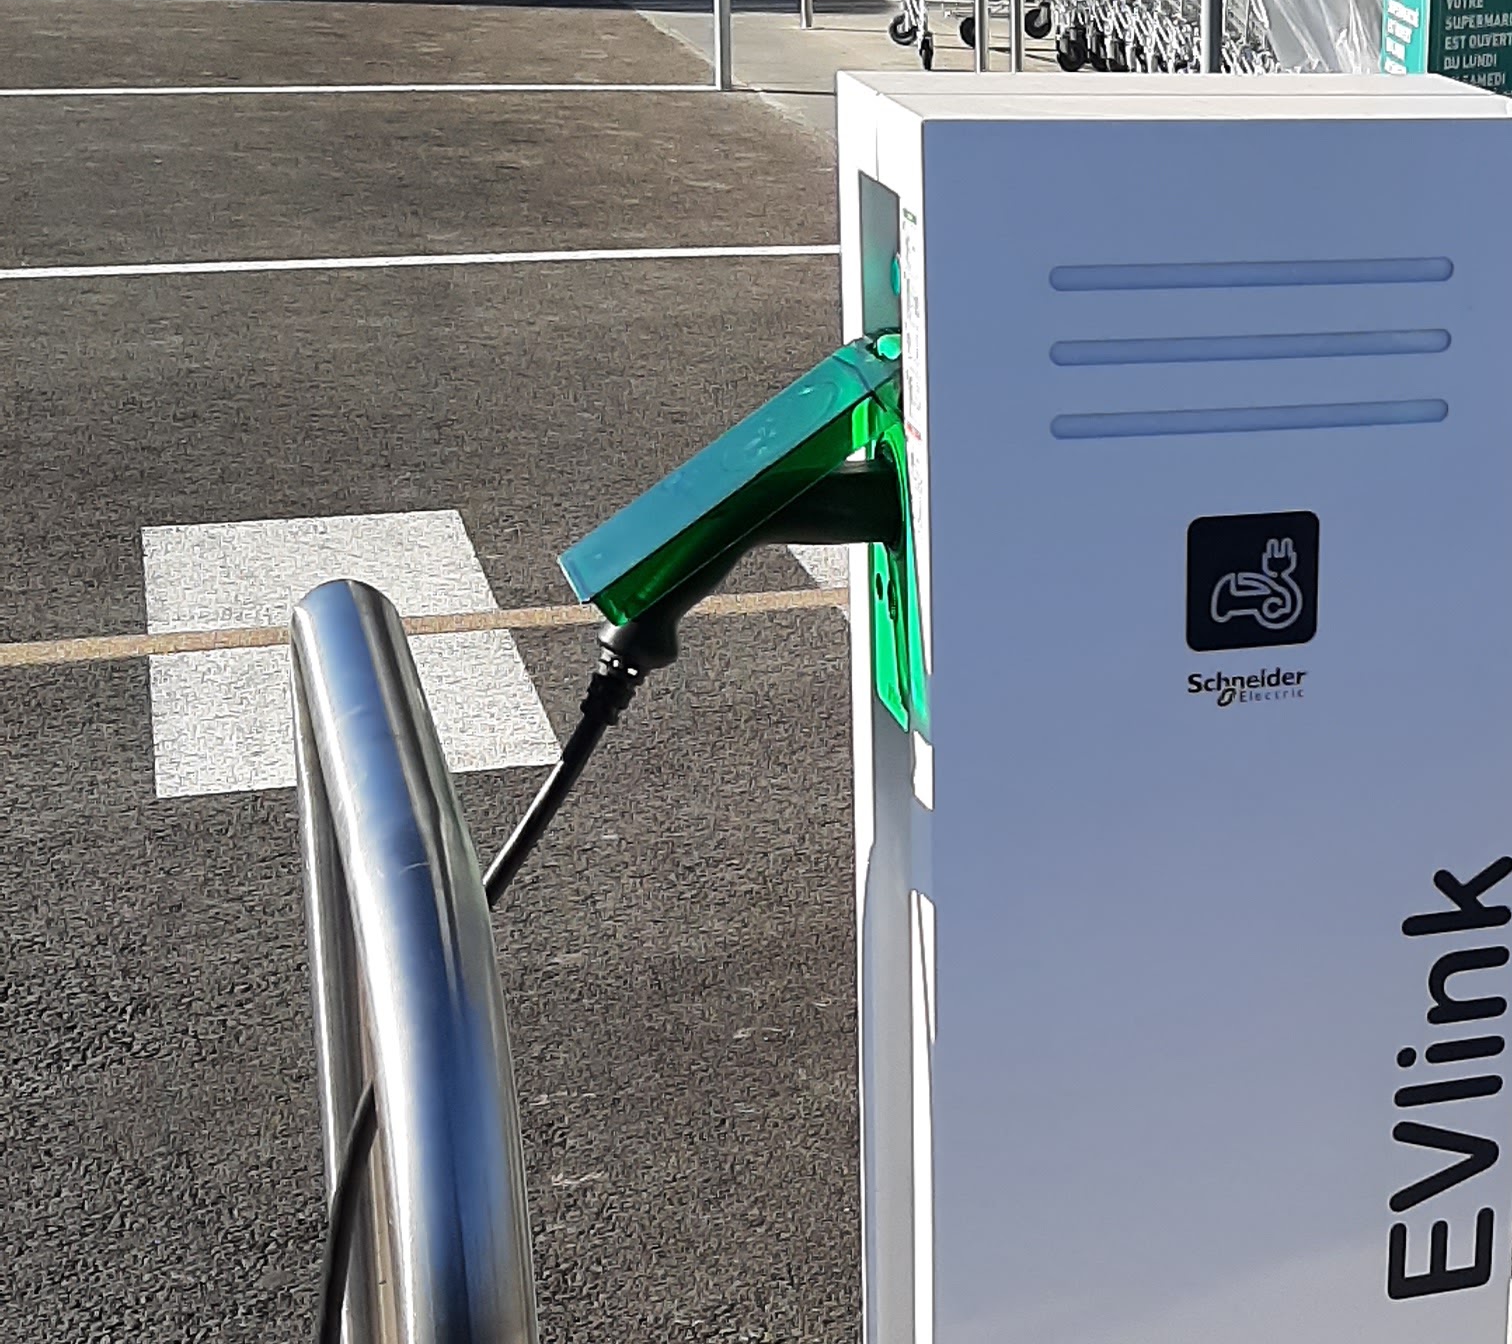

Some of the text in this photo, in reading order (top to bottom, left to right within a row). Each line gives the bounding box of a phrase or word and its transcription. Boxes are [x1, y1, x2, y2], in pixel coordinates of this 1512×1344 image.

[1444, 35, 1467, 50] EST
[1443, 53, 1498, 71] DU LUNDI
[1187, 666, 1308, 694] Schneider
[1240, 688, 1305, 703] Electric
